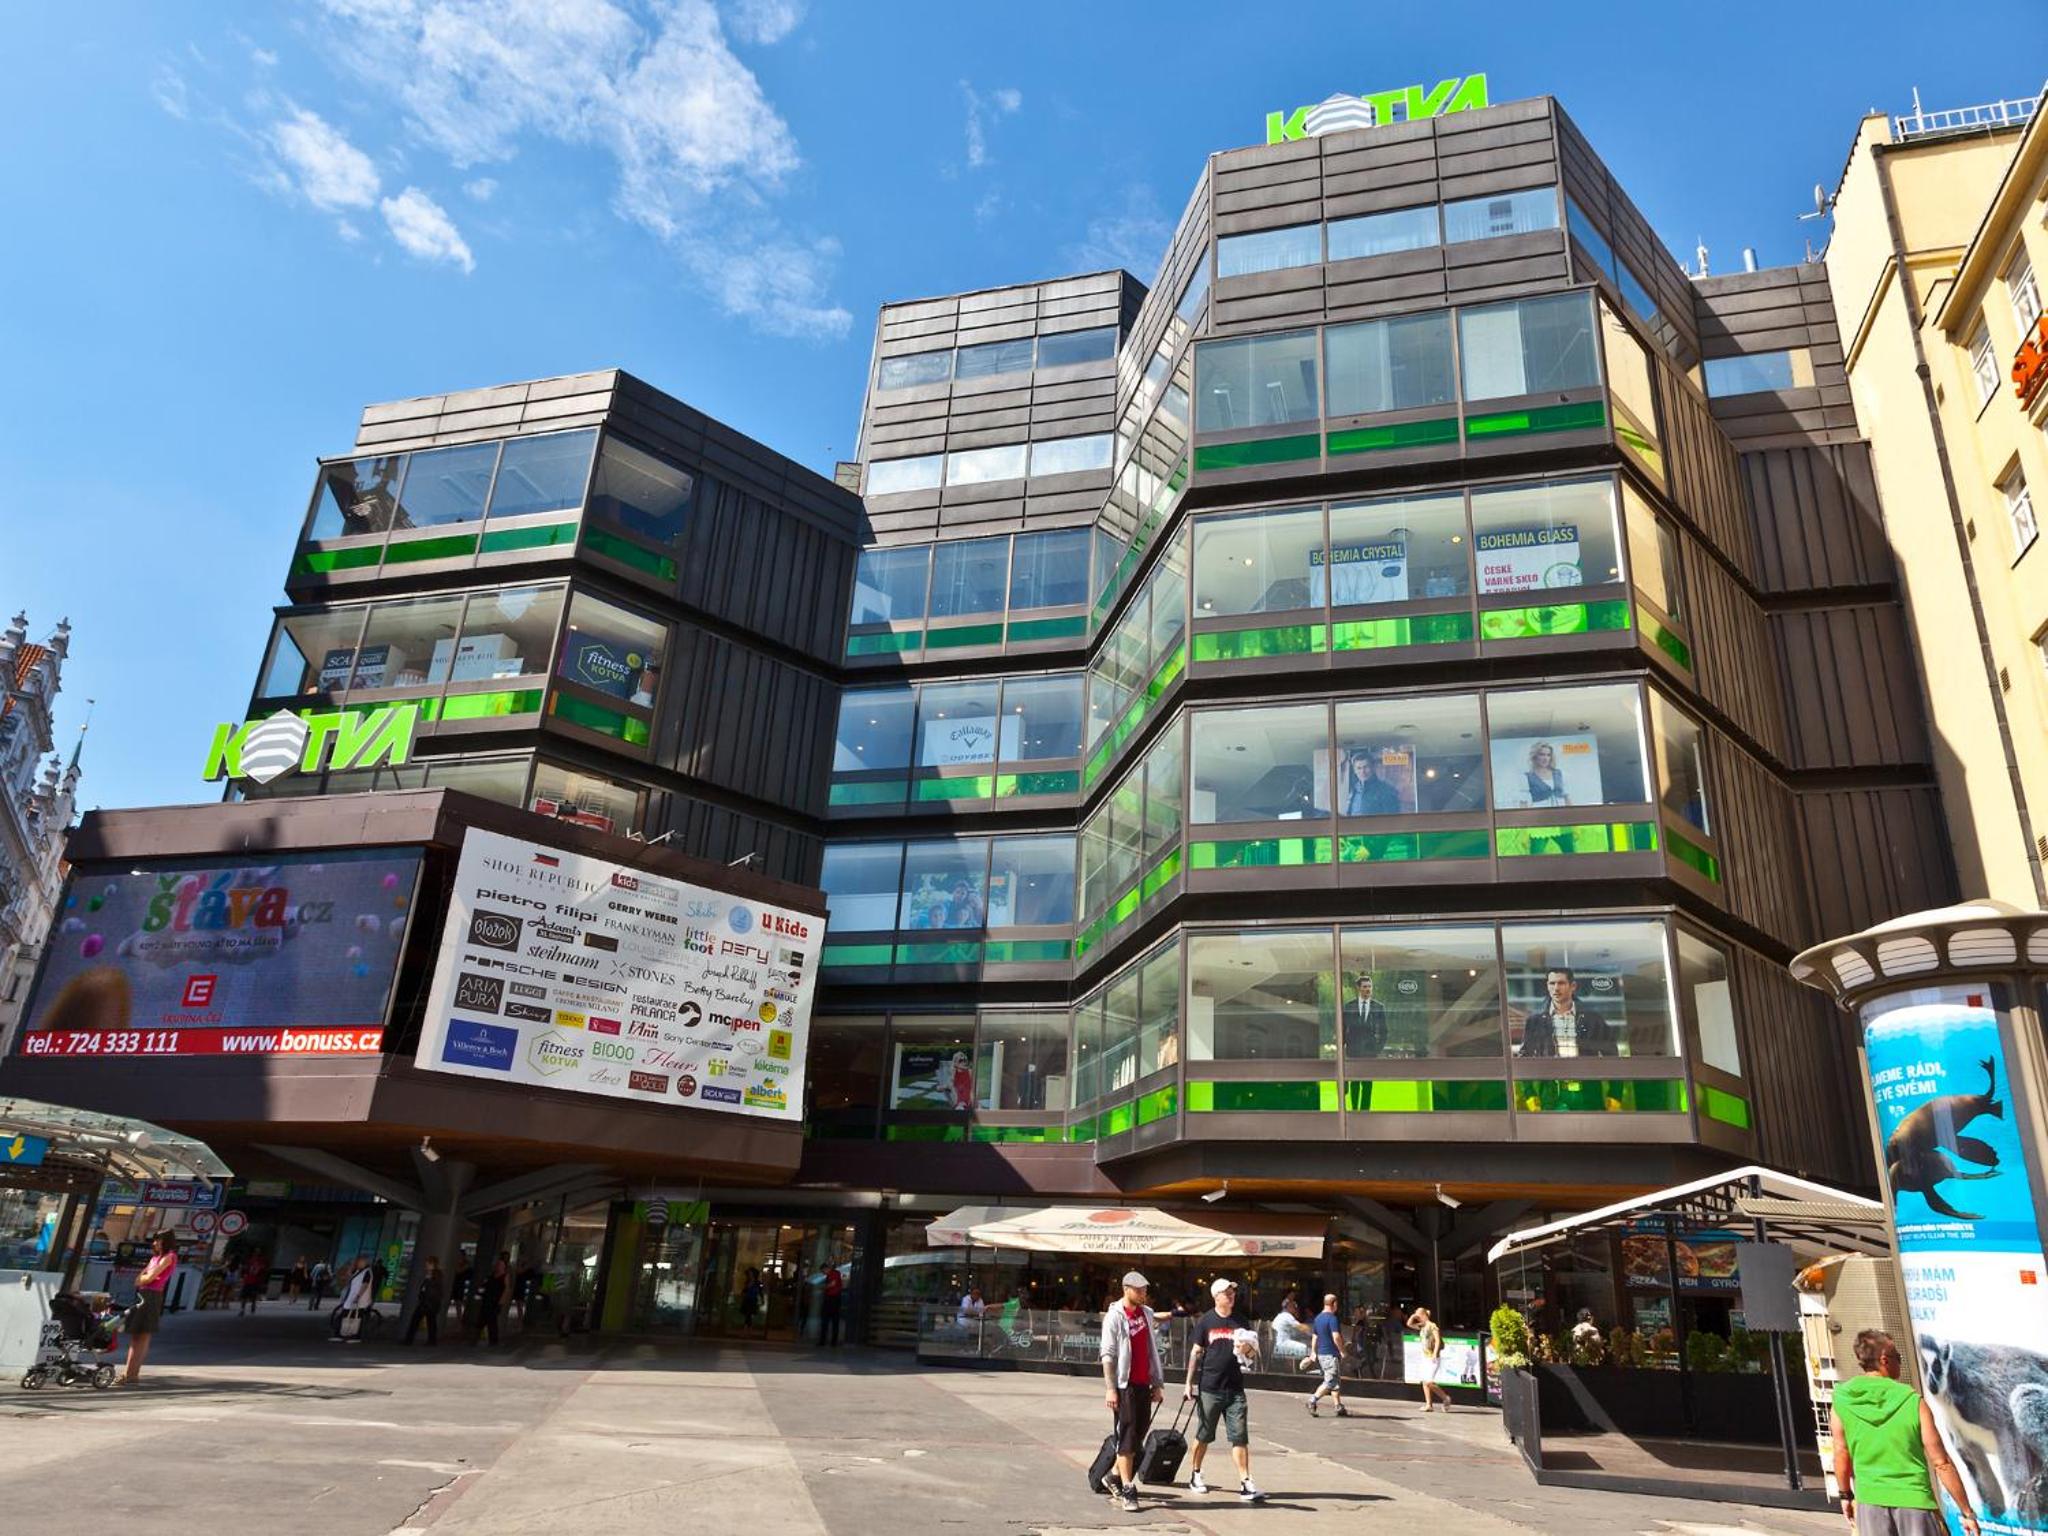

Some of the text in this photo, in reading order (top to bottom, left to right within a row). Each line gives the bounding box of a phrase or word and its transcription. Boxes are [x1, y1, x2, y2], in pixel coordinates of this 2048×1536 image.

[1266, 73, 1488, 144] KOTVA
[1480, 528, 1574, 549] BOHEMIA GLASS
[1362, 544, 1405, 559] CRYSTAL
[586, 651, 631, 675] fitness
[591, 663, 625, 683] KOTVA
[203, 704, 421, 784] KOTVA
[482, 857, 598, 893] SHOE REPUBLIC
[476, 888, 598, 922] pietro filipi
[608, 901, 678, 925] GERRY WEBER
[604, 918, 676, 942] FRANK LYMAN
[685, 925, 716, 944] little
[762, 913, 808, 938] U Kids
[684, 938, 714, 955] foot
[527, 944, 599, 970] steilmann
[464, 954, 628, 995] PORSCHE DESIGN
[628, 966, 676, 986] STONES
[461, 977, 499, 995] ARIA
[459, 989, 497, 1008] PURA
[683, 980, 755, 1013] Betty Barclay
[26, 1032, 179, 1053] tel.: 724 333 111
[222, 1029, 382, 1052] www.bonuss.cz
[664, 1033, 684, 1044] Sony
[538, 1040, 585, 1058] fitness
[542, 1054, 579, 1069] KOTVA
[642, 1047, 698, 1072] Fleurs
[1906, 1061, 1946, 1078] RÁDI,
[751, 1081, 783, 1098] albert
[1895, 1079, 1937, 1098] SVÉM!
[1711, 1278, 1740, 1288] GYRO
[1922, 1264, 1956, 1282] MÁM
